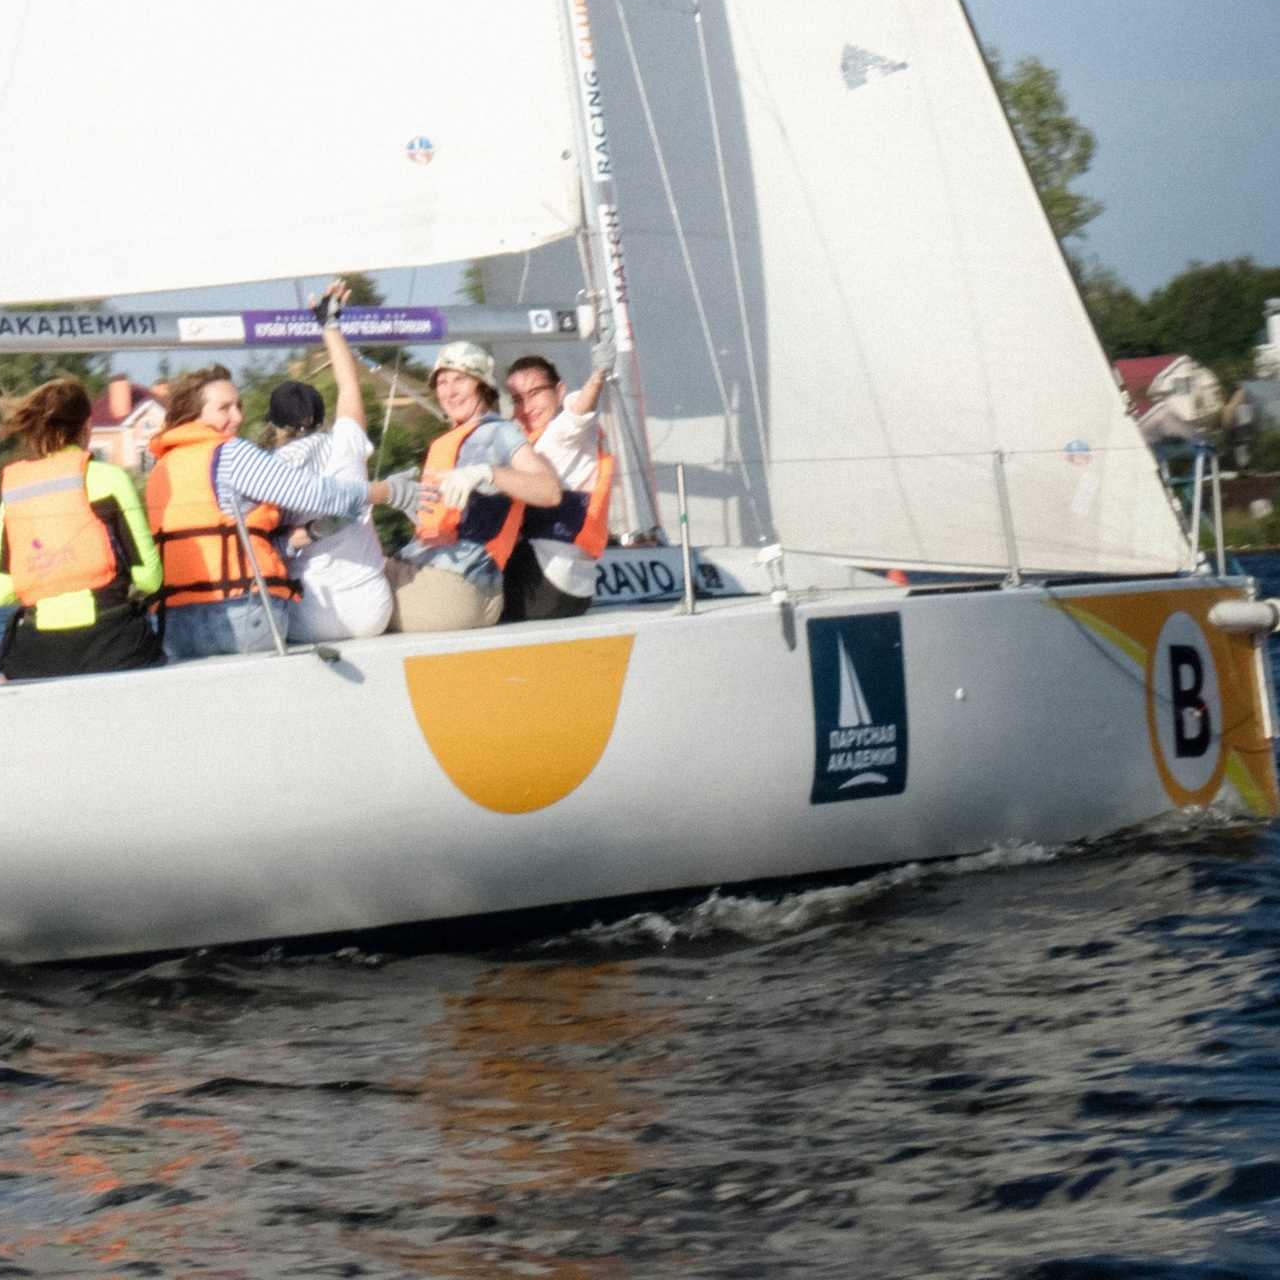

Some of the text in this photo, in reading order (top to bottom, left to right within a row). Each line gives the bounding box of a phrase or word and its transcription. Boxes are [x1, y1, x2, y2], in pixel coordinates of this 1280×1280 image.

[584, 70, 611, 175] RACING
[593, 559, 675, 596] RAVO
[1169, 645, 1211, 759] B
[829, 724, 897, 750] ПАРУСНАЯ
[827, 746, 897, 772] АКАДЕМИЯ
